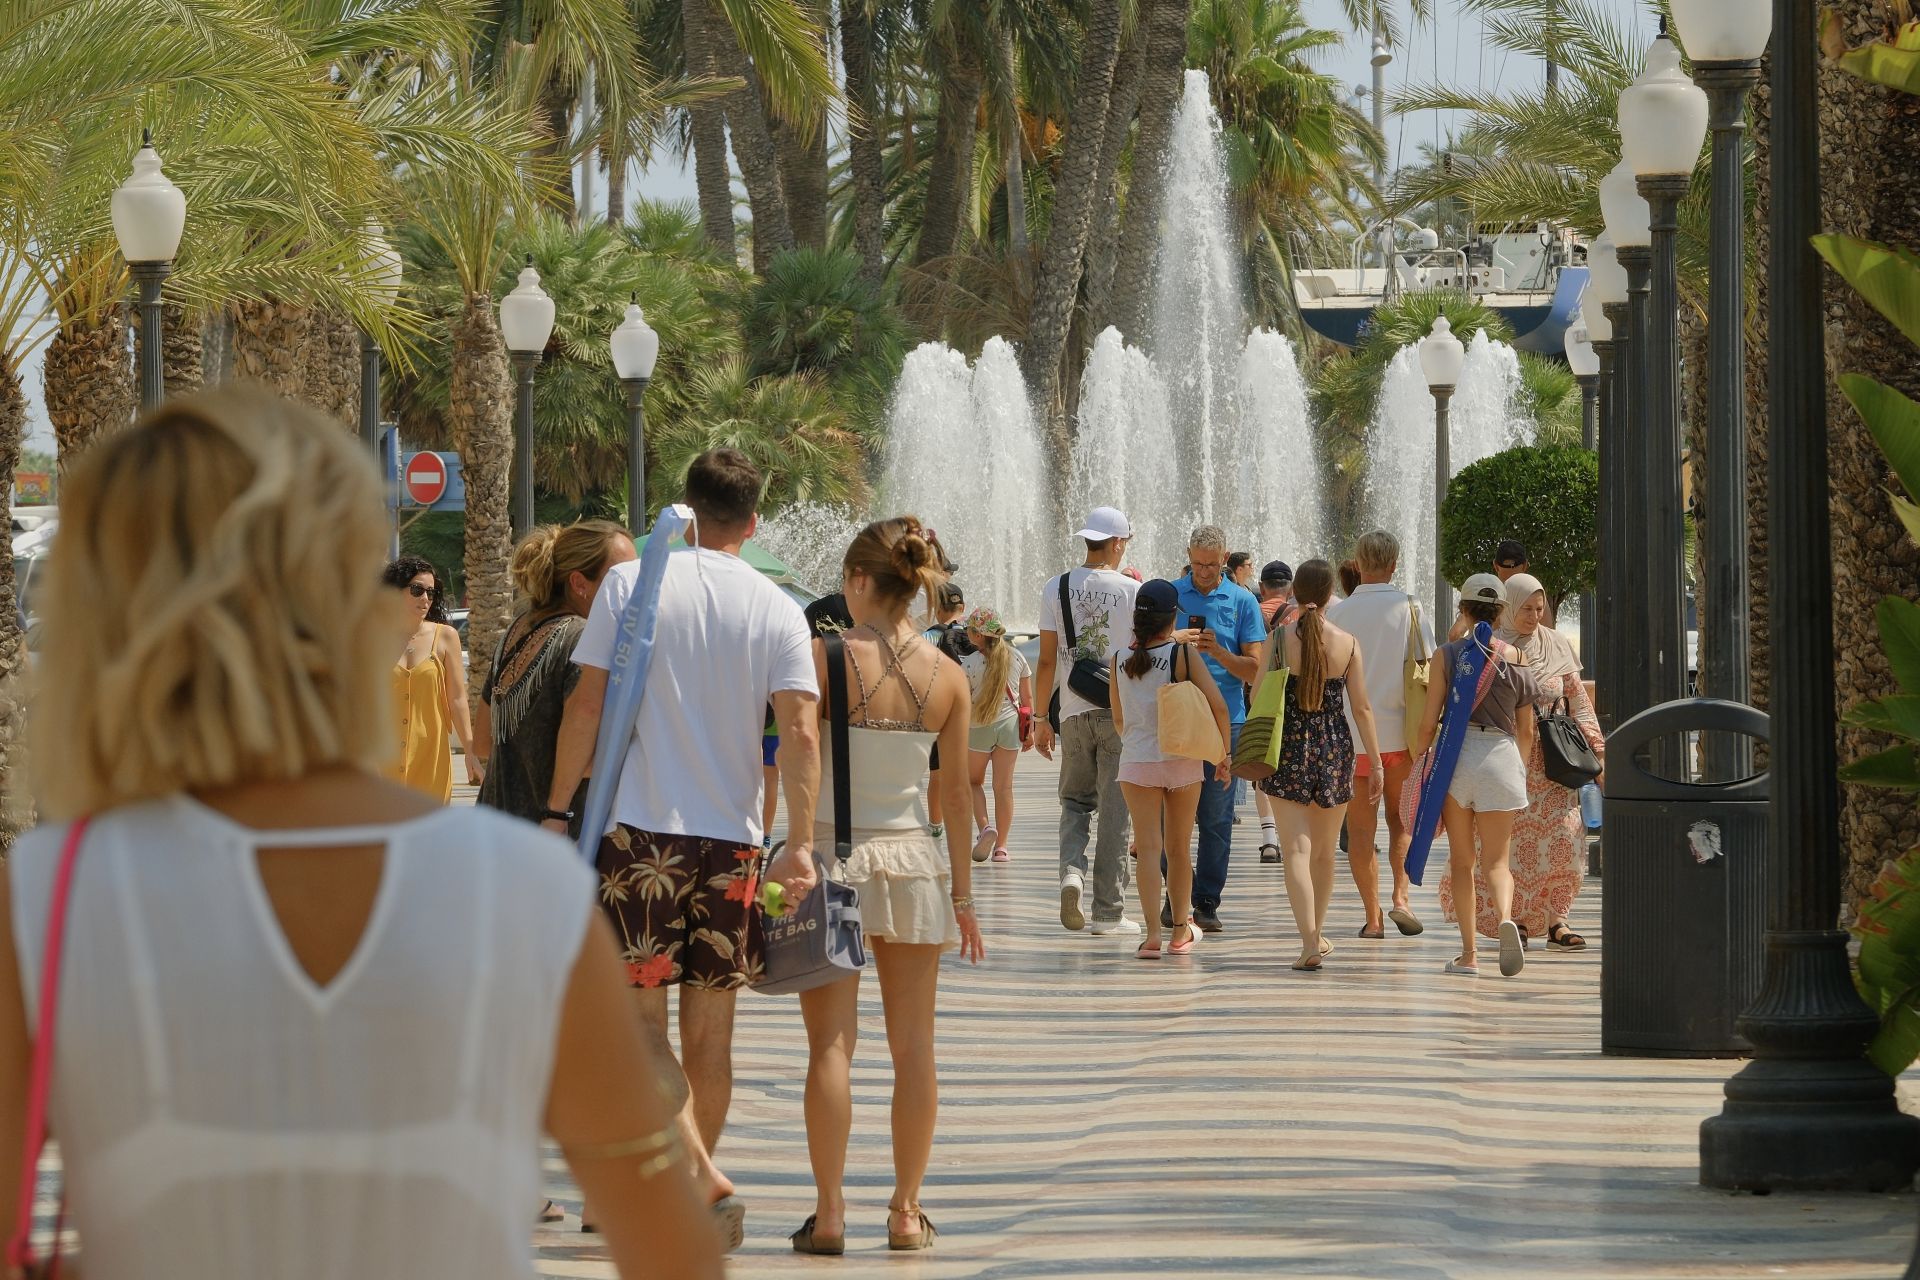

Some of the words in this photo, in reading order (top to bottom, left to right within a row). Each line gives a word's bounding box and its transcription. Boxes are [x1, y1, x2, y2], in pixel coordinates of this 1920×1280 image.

[623, 606, 639, 637] UV
[767, 929, 782, 942] TE
[787, 919, 816, 936] BAG
[772, 914, 795, 927] THE
